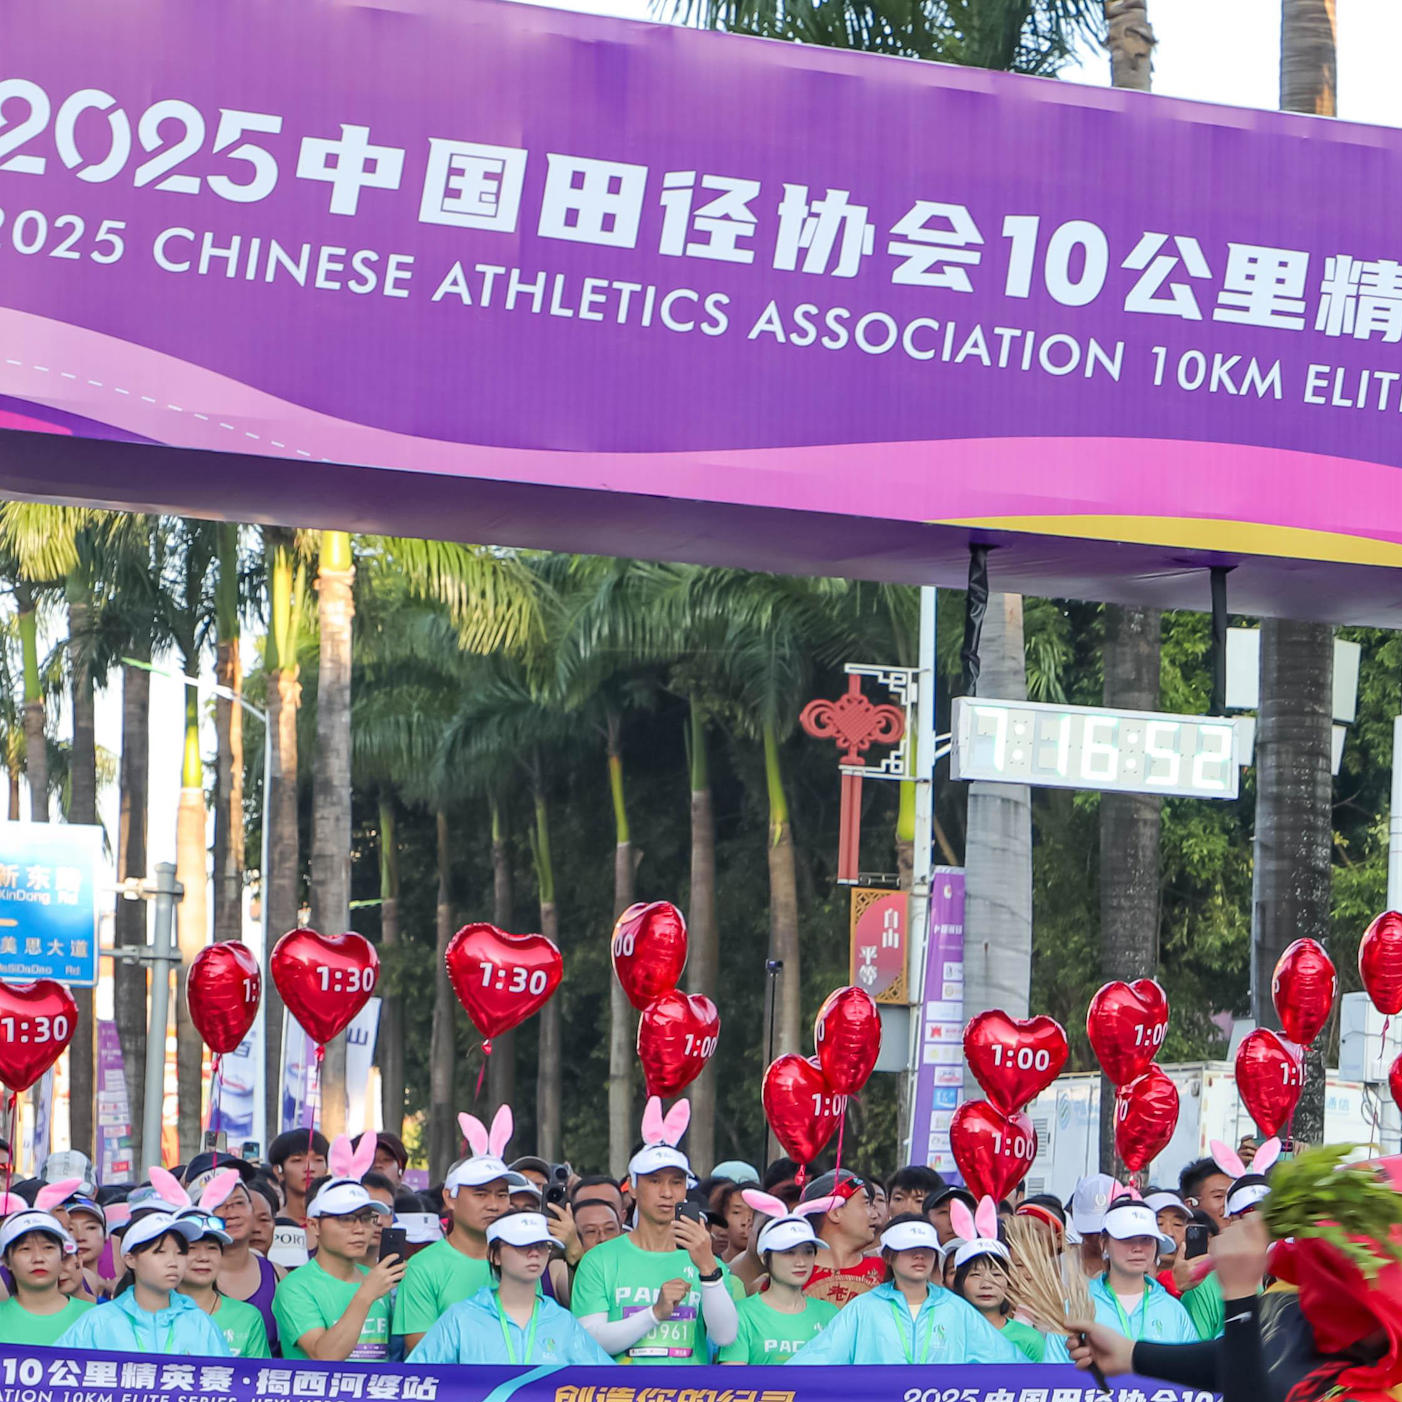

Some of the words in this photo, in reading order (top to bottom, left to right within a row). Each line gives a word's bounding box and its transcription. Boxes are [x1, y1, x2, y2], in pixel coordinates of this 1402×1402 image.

[0, 208, 126, 265] 025
[153, 226, 413, 298] CHINESE
[431, 261, 730, 336] ATHLETICS
[747, 299, 1124, 382] ASSOCIATION
[1150, 346, 1284, 399] 10KM
[316, 966, 375, 993] 1:30
[479, 961, 547, 996] 1:30
[1, 1015, 68, 1043] 1:30
[991, 1043, 1050, 1072] 1:00
[991, 1132, 1035, 1160] 1:00
